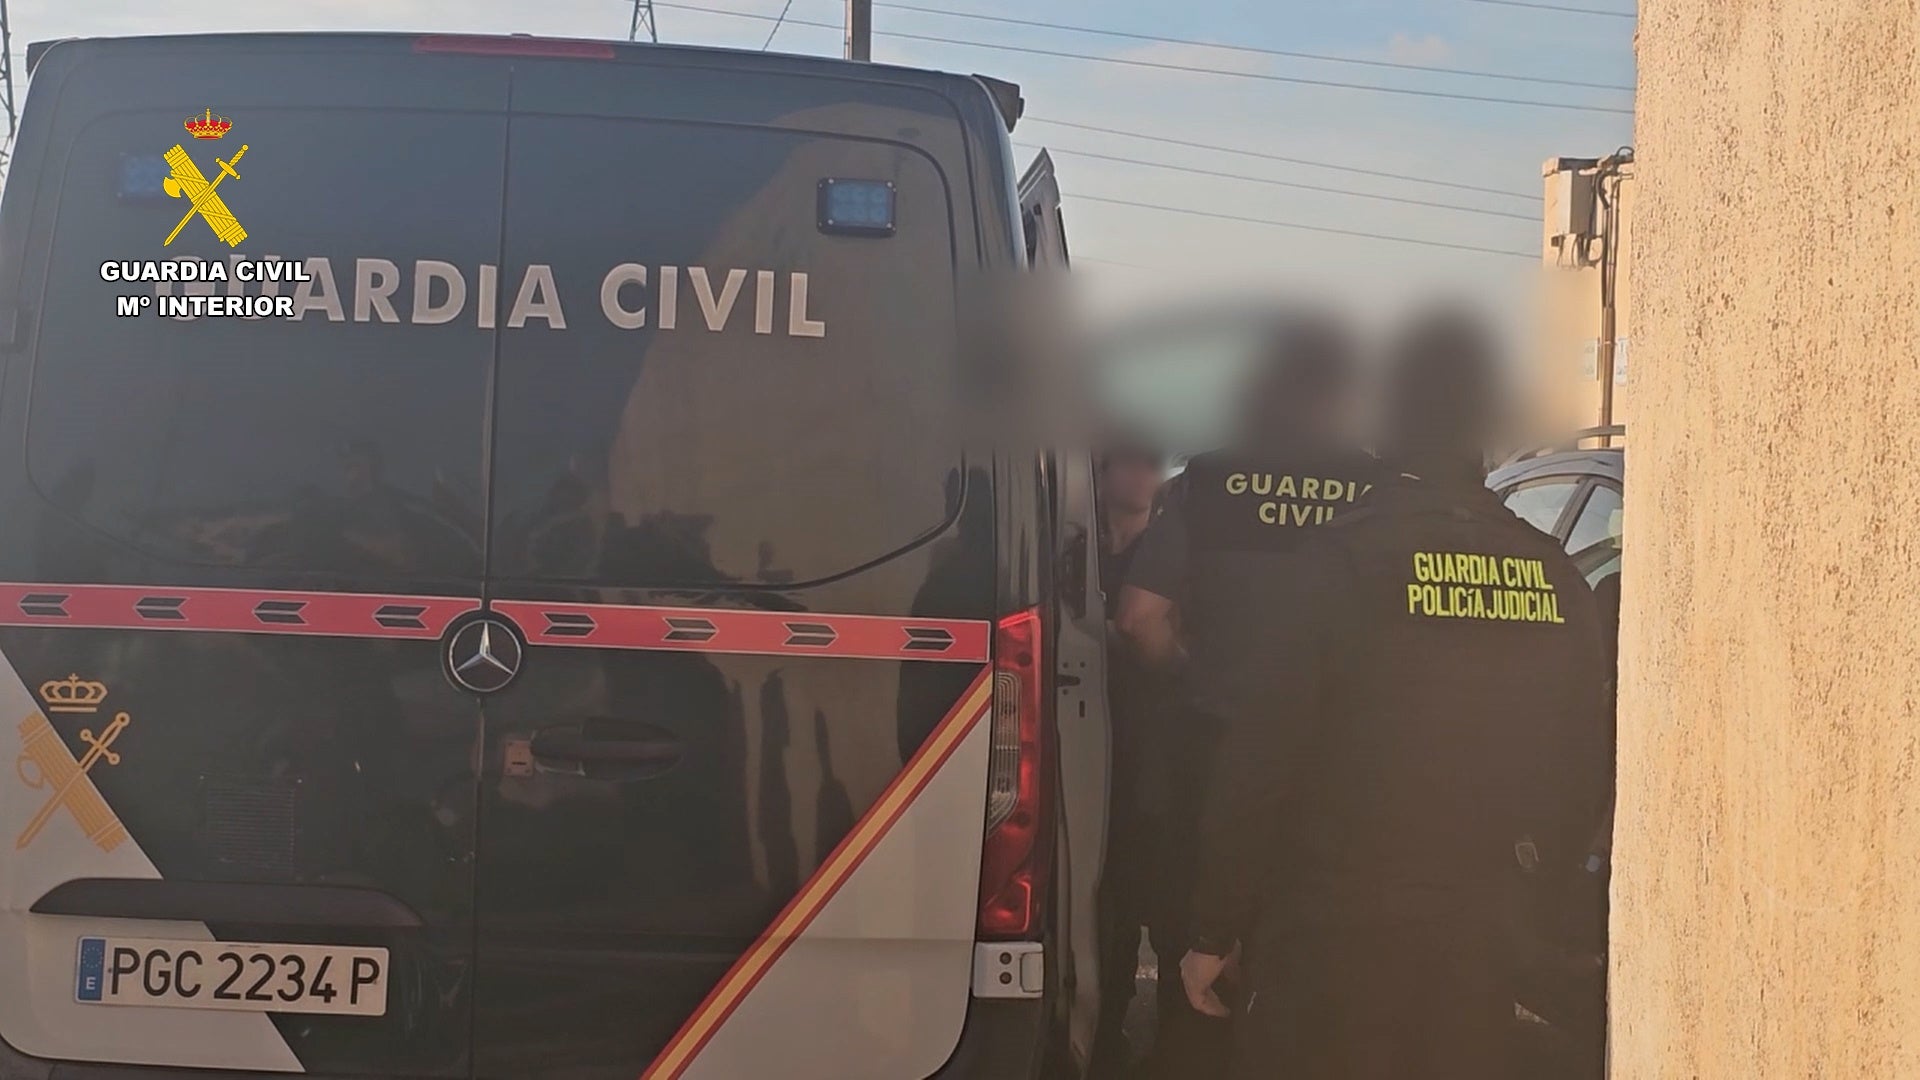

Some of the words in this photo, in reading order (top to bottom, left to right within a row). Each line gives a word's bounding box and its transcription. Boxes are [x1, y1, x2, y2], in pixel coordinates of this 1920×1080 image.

[600, 262, 826, 337] CIVIL
[1225, 473, 1373, 502] GUARDI
[1413, 552, 1501, 586] GUARDIA
[1503, 556, 1554, 590] CIVIL
[1486, 589, 1565, 624] JUDICIAL
[85, 976, 96, 991] E
[111, 947, 203, 998] PGC
[213, 952, 338, 1004] 2234
[350, 957, 381, 1005] P
